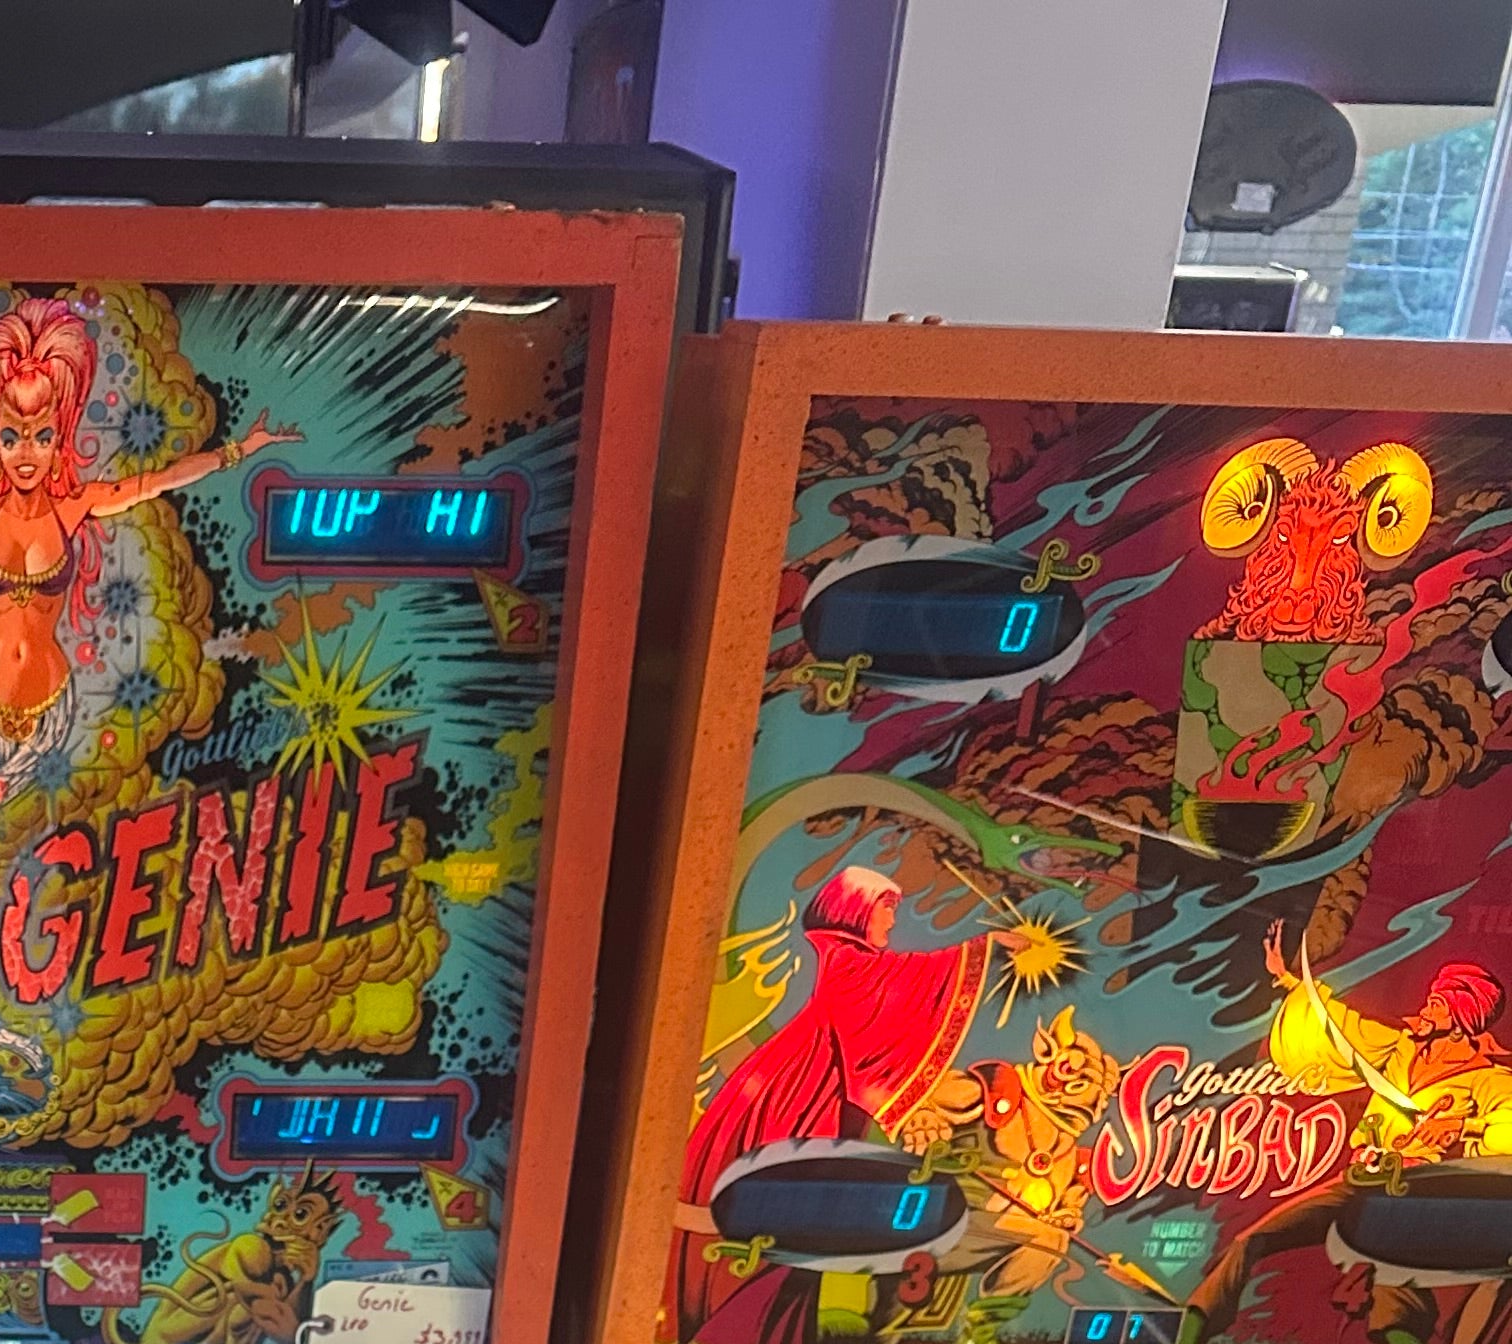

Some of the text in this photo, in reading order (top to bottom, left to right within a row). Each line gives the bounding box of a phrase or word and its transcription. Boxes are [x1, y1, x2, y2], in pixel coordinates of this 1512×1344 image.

[507, 602, 540, 644] 2
[999, 602, 1039, 653] 0
[0, 740, 420, 1003] GENIE
[1173, 1061, 1334, 1106] Gottlieb's
[444, 1191, 480, 1224] 4
[892, 1185, 930, 1230] 0
[1149, 1220, 1208, 1238] NUMBER
[1142, 1240, 1208, 1259] TO MATCH
[357, 1286, 416, 1312] Genie
[898, 1250, 936, 1305] 3
[1331, 1262, 1372, 1316] 4
[1086, 1312, 1113, 1341] 0
